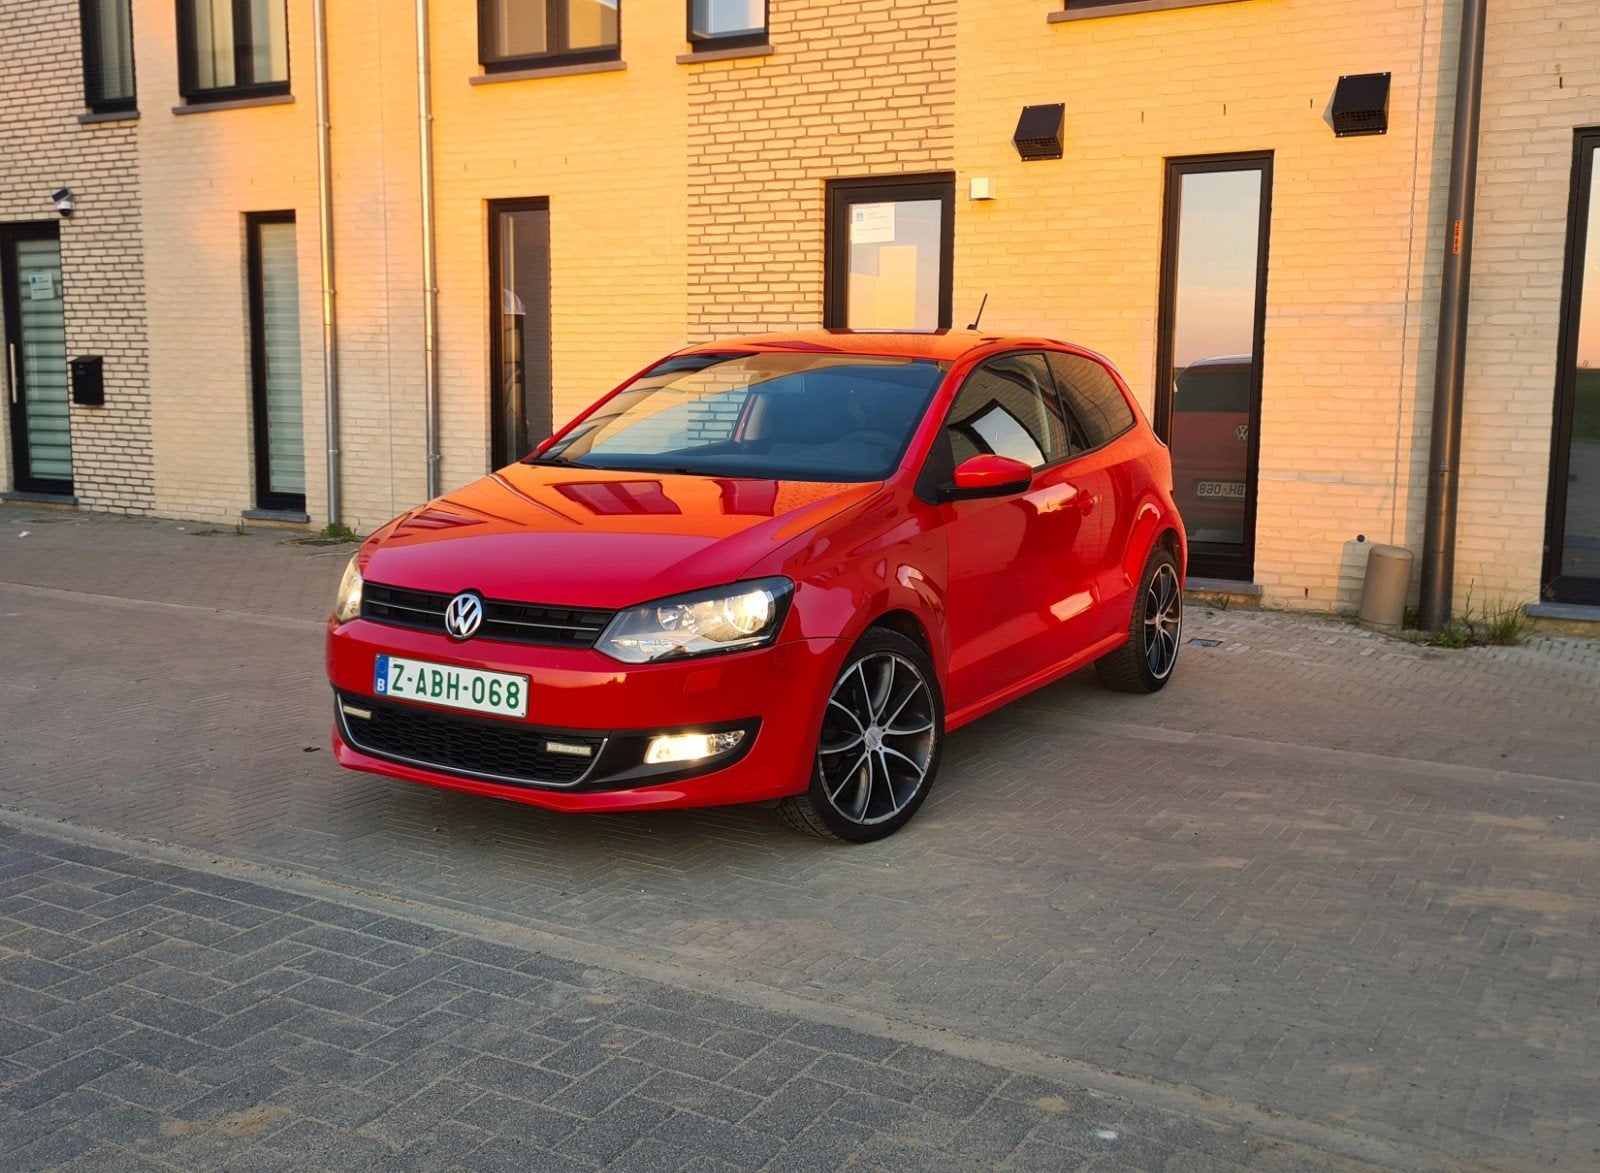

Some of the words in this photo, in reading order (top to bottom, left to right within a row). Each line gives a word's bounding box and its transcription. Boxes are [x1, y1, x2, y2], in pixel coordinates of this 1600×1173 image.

[446, 593, 482, 640] VW
[377, 678, 386, 692] B
[392, 664, 520, 709] Z-ABH-068
